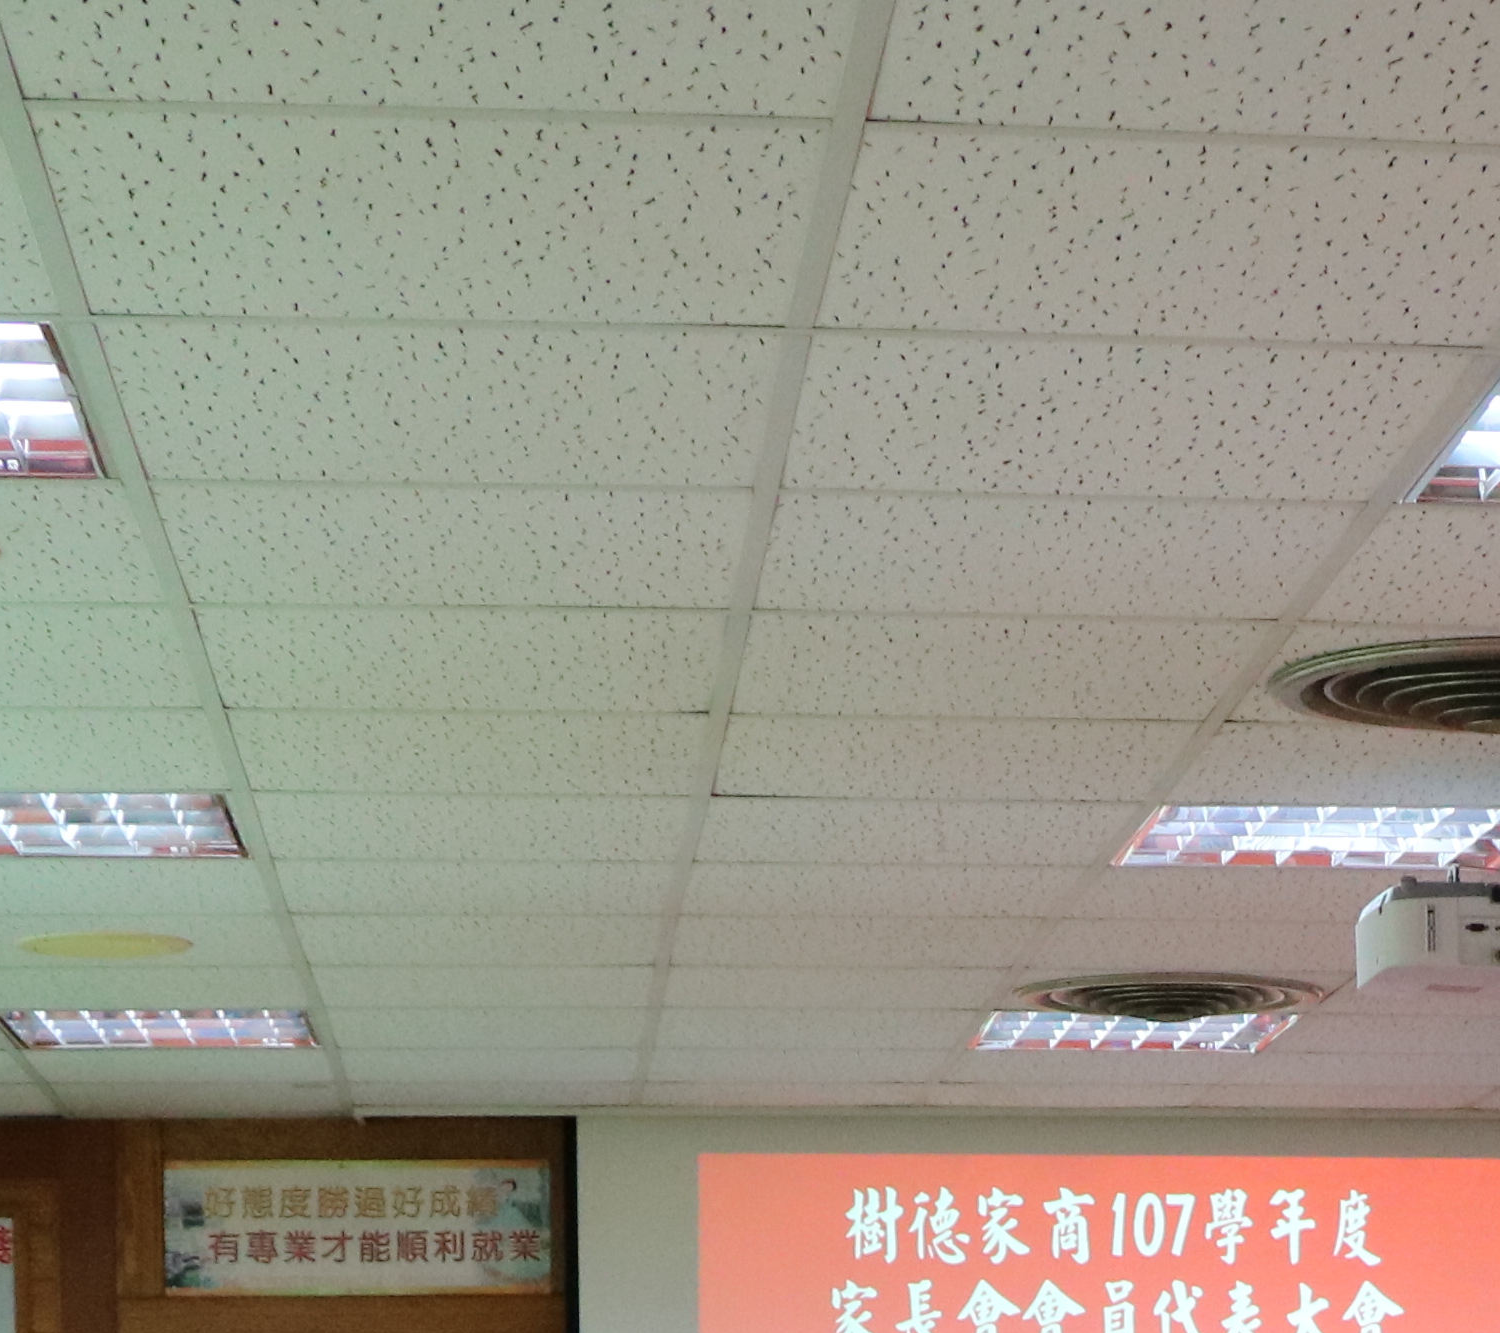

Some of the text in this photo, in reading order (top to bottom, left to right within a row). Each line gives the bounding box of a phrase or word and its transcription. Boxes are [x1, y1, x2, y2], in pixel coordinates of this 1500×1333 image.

[203, 1185, 498, 1219] 好態度勝過好成績
[845, 1186, 1383, 1265] 樹德家商107學年度
[208, 1229, 541, 1264] 有專業才能順利就業
